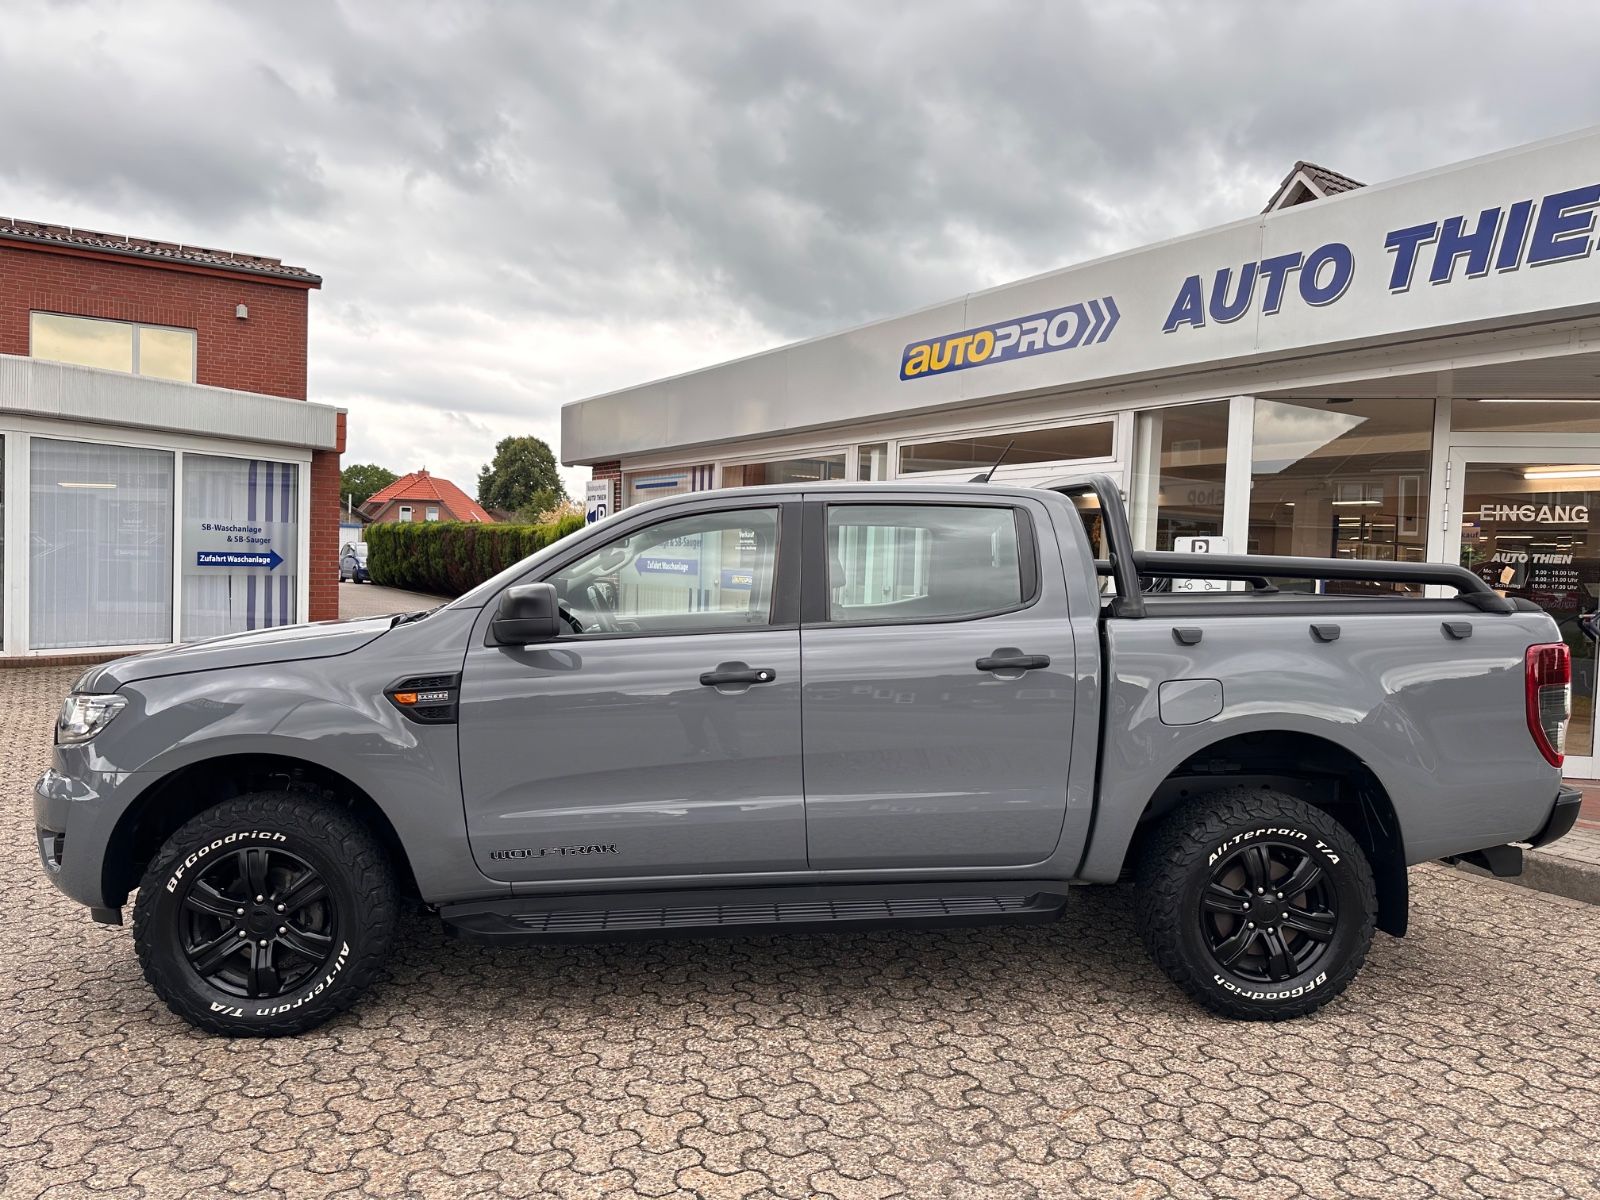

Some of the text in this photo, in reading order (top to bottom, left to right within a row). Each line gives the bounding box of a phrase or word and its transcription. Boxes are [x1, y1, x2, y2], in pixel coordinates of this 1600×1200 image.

[1161, 183, 1600, 334] AUTO THIE
[1480, 504, 1589, 522] EINGANG
[201, 523, 262, 534] SB-Waschanlage
[226, 535, 271, 545] & SB-Sauger
[200, 555, 271, 564] Zufahrt Waschanlage
[647, 560, 662, 570] Zufahrt
[1491, 552, 1573, 564] AUTO THIEN
[1208, 828, 1340, 866] All-Terrain T/A
[166, 830, 287, 893] BFGoodrich
[210, 940, 351, 1018] All-Terrain T/A
[1213, 971, 1328, 1000] BFGoodrich
